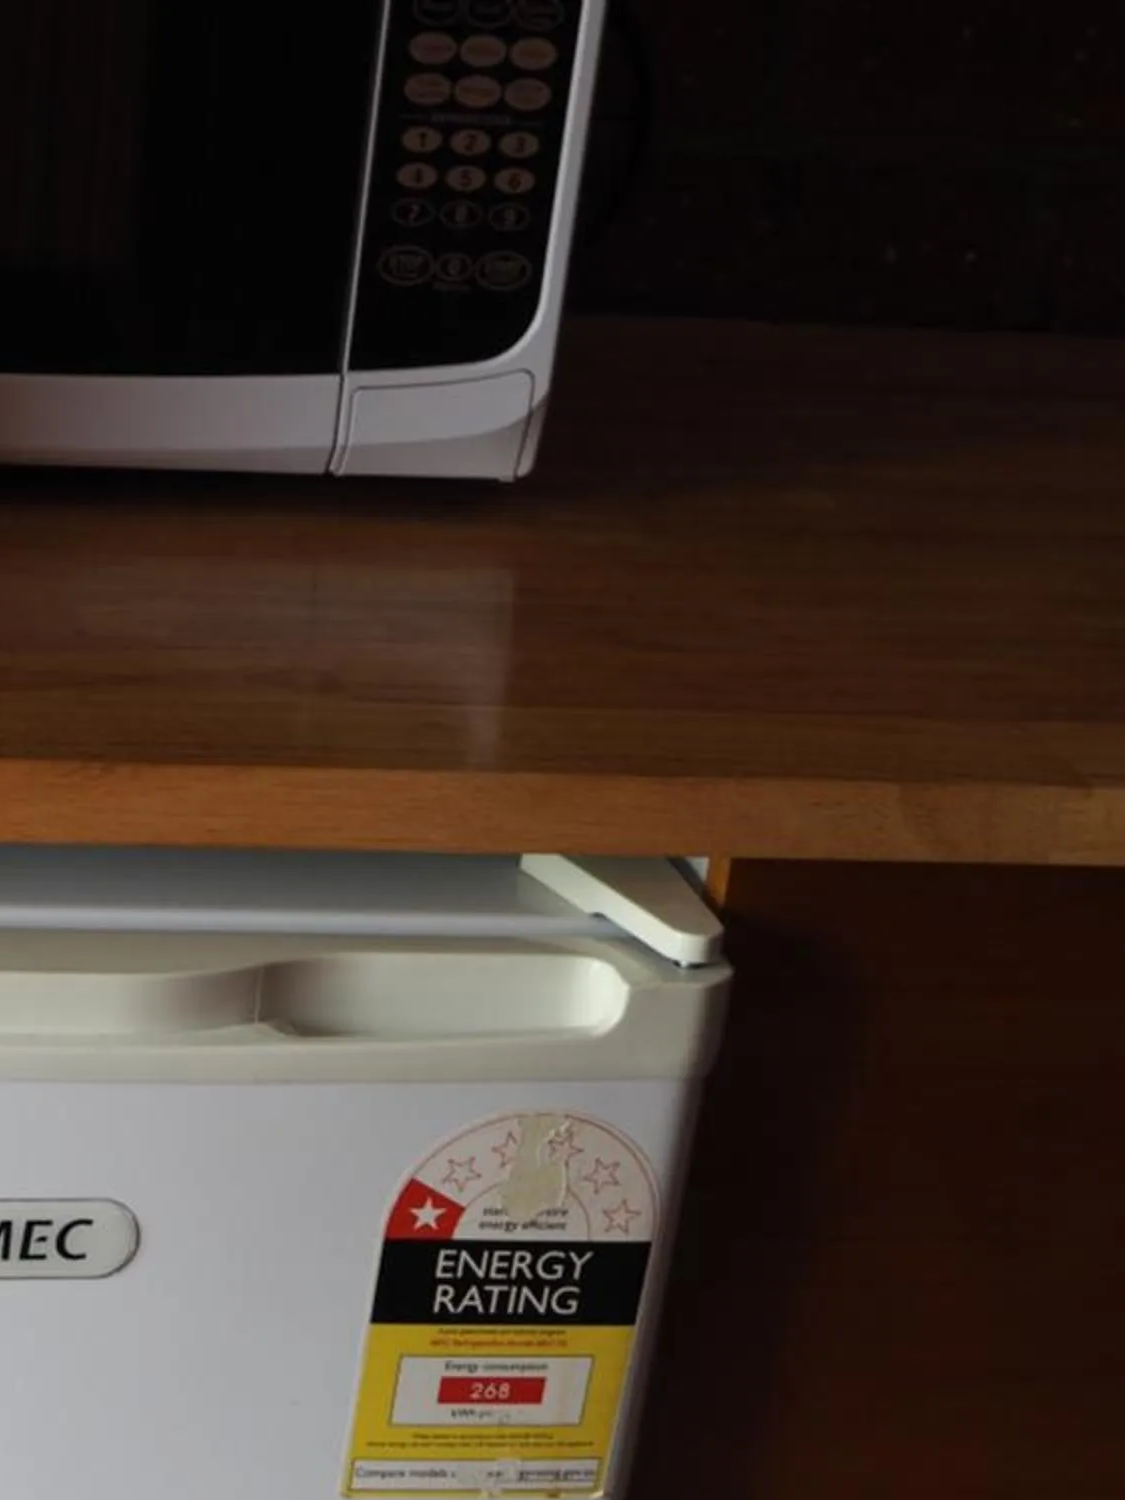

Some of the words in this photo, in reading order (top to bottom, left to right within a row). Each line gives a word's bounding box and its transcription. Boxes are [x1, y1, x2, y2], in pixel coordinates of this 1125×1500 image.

[435, 1249, 594, 1281] ENERGY
[432, 1284, 581, 1315] RATING
[445, 1360, 479, 1374] Energy
[469, 1382, 512, 1400] 268
